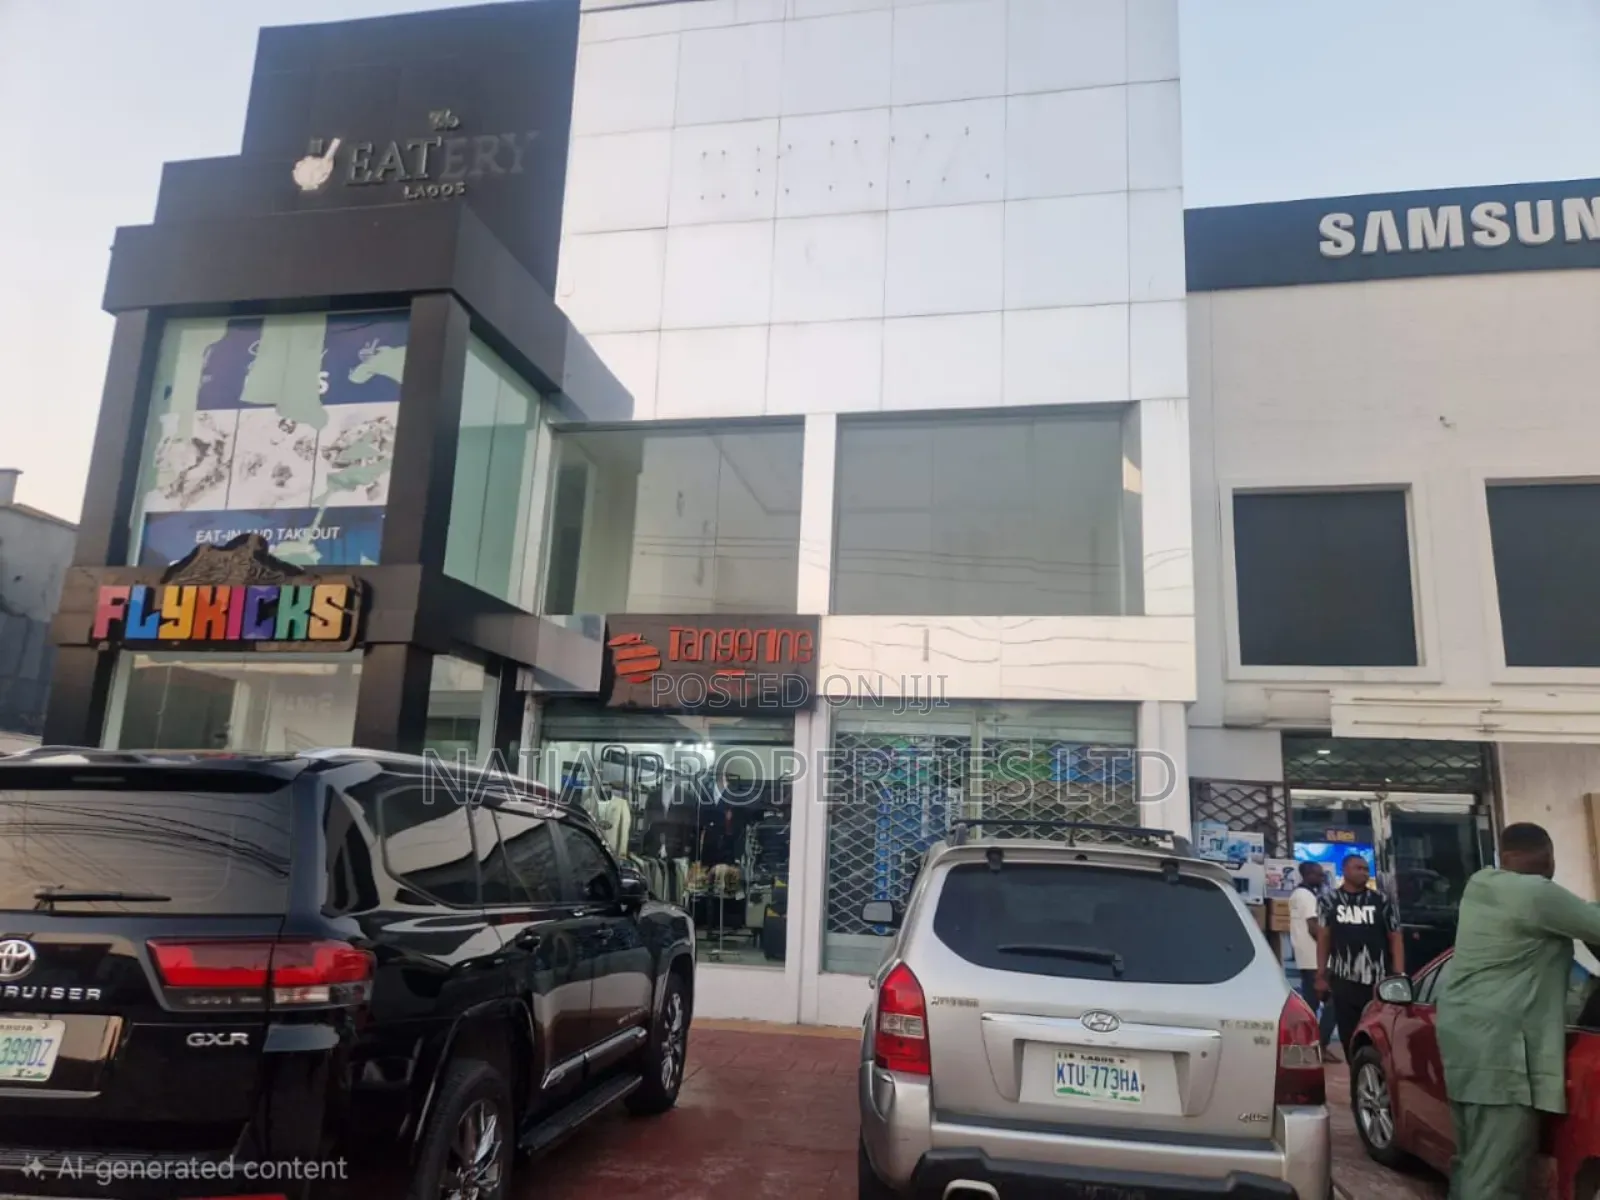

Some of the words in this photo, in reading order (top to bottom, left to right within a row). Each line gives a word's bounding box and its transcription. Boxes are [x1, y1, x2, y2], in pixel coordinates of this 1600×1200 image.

[344, 130, 540, 186] EATERY
[92, 583, 347, 640] FLYKICKS
[1336, 904, 1376, 925] SAINT
[0, 985, 101, 1000] RUISER
[186, 1032, 249, 1047] GXR
